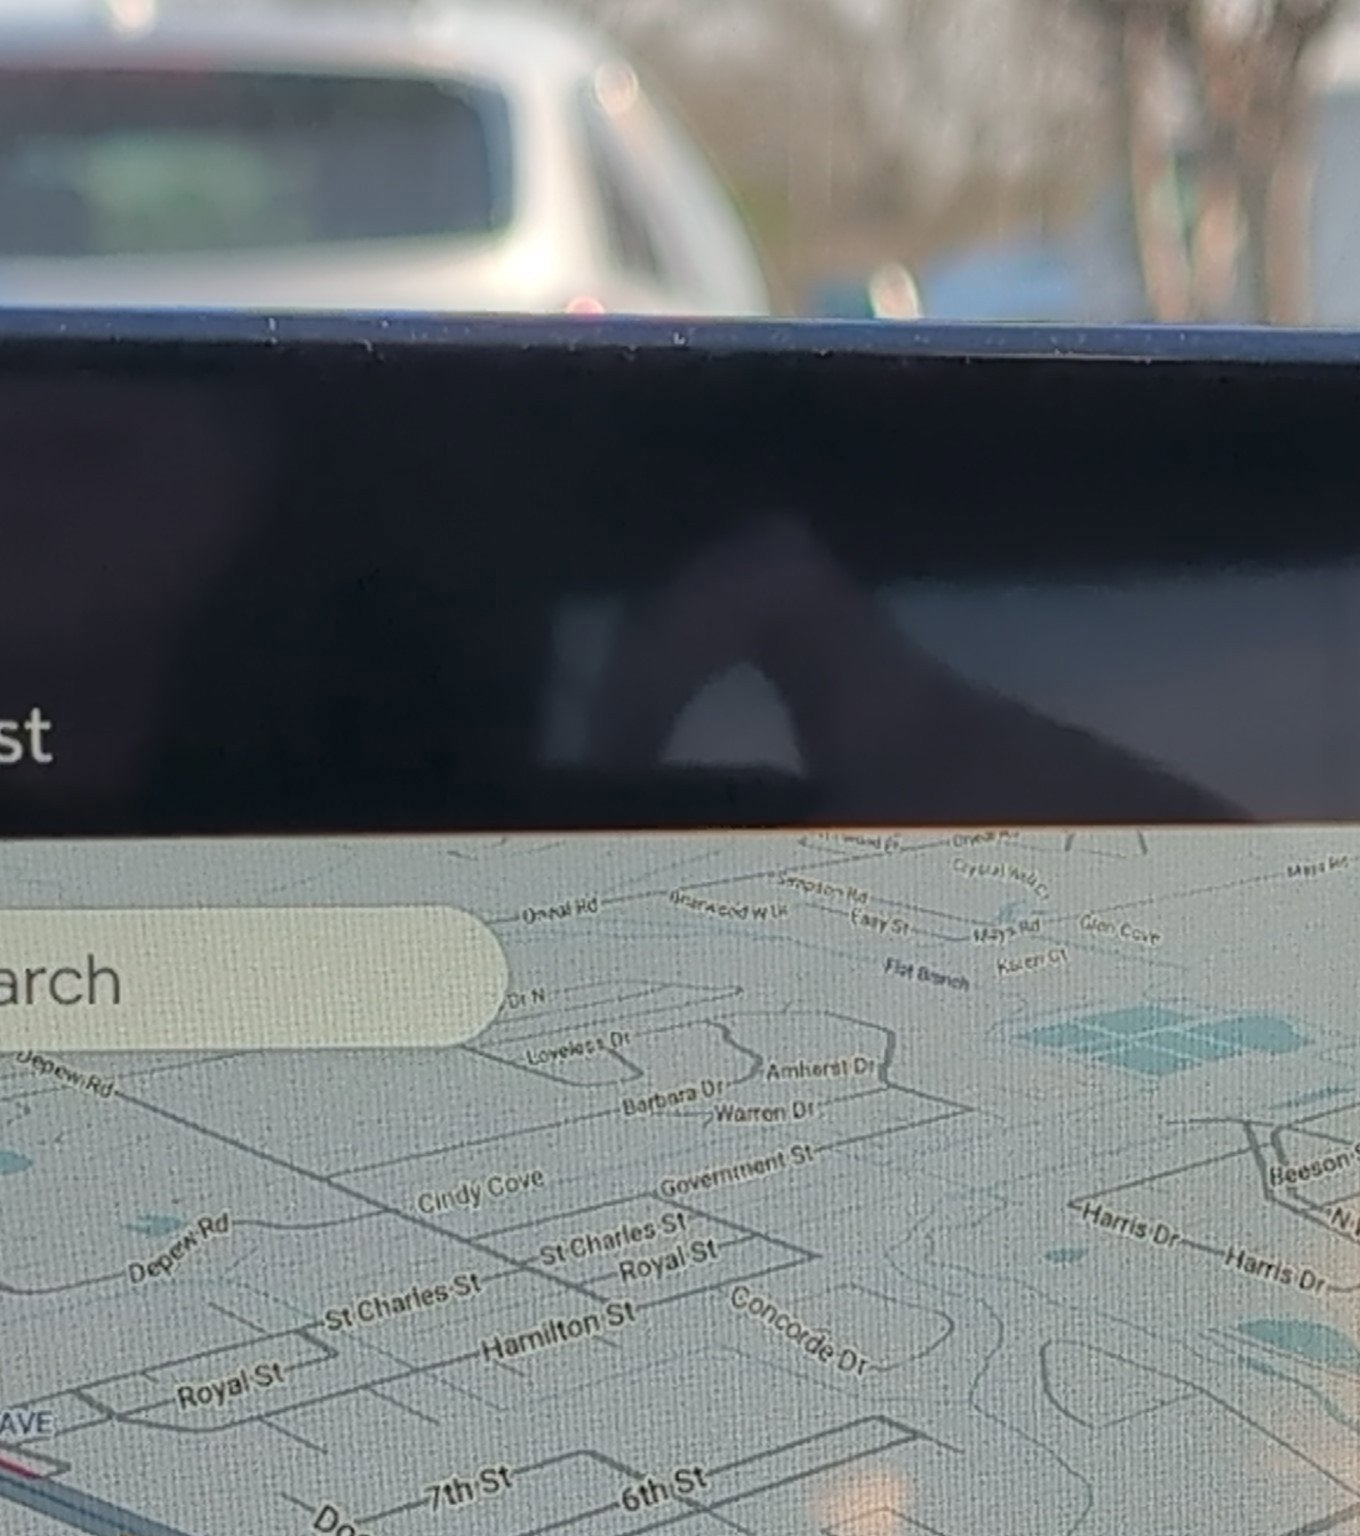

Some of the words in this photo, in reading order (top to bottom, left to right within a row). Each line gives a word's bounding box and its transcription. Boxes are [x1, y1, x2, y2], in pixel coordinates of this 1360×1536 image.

[765, 1060, 850, 1082] Amherst
[852, 1056, 877, 1076] Dr
[623, 1086, 699, 1118] Barbara
[700, 1077, 725, 1099] Dr
[714, 1099, 790, 1124] Warren
[792, 1096, 818, 1119] Dr
[416, 1185, 484, 1217] Cindy
[486, 1168, 545, 1197] Cove
[659, 1154, 790, 1199] Government
[790, 1142, 816, 1166] St
[1269, 1150, 1356, 1187] Beeson
[540, 1241, 566, 1267] St
[568, 1219, 659, 1260] Charles
[659, 1211, 690, 1236] St
[1081, 1202, 1148, 1244] Harris
[1151, 1224, 1181, 1251] Dr
[1332, 1205, 1353, 1231] N
[129, 1230, 198, 1286] Depew
[197, 1213, 231, 1242] Rd
[619, 1251, 689, 1284] Royal
[691, 1238, 719, 1264] St
[1224, 1247, 1295, 1290] Harris
[1297, 1269, 1327, 1297] Dr
[323, 1306, 355, 1333] St
[357, 1287, 454, 1327] Charles
[453, 1273, 484, 1301] St
[481, 1316, 605, 1366] Hamilton
[606, 1301, 639, 1330] St
[730, 1284, 839, 1366] Concorde
[839, 1350, 872, 1378] Dr
[176, 1375, 254, 1413] Royal
[253, 1361, 286, 1388] St
[423, 1482, 475, 1514] 7th
[477, 1465, 514, 1496] St
[623, 1479, 672, 1513] 6th
[674, 1464, 708, 1493] St
